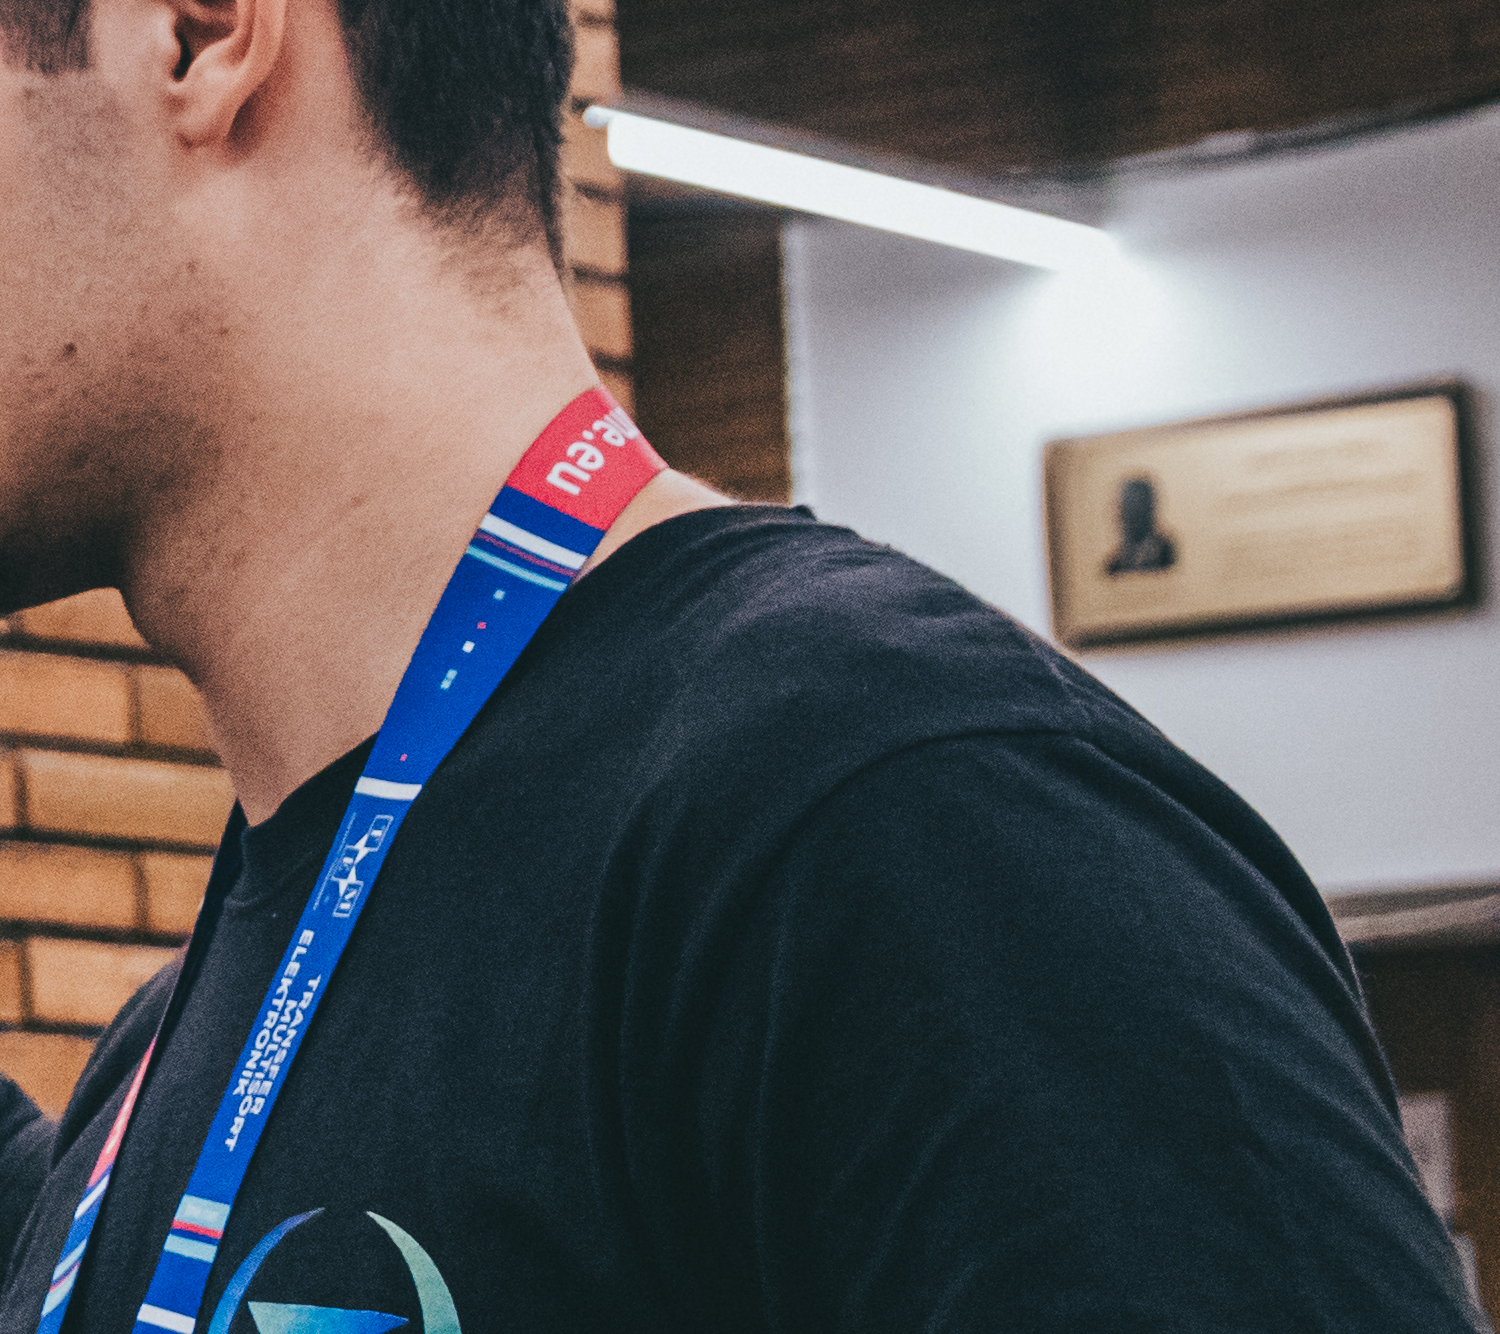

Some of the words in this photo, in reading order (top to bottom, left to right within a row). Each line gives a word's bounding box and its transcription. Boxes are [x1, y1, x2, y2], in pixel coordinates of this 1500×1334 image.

[224, 999, 298, 1152] MULTISORT
[232, 929, 315, 1096] ELEKTRONIK
[249, 973, 321, 1116] TRANSFER
